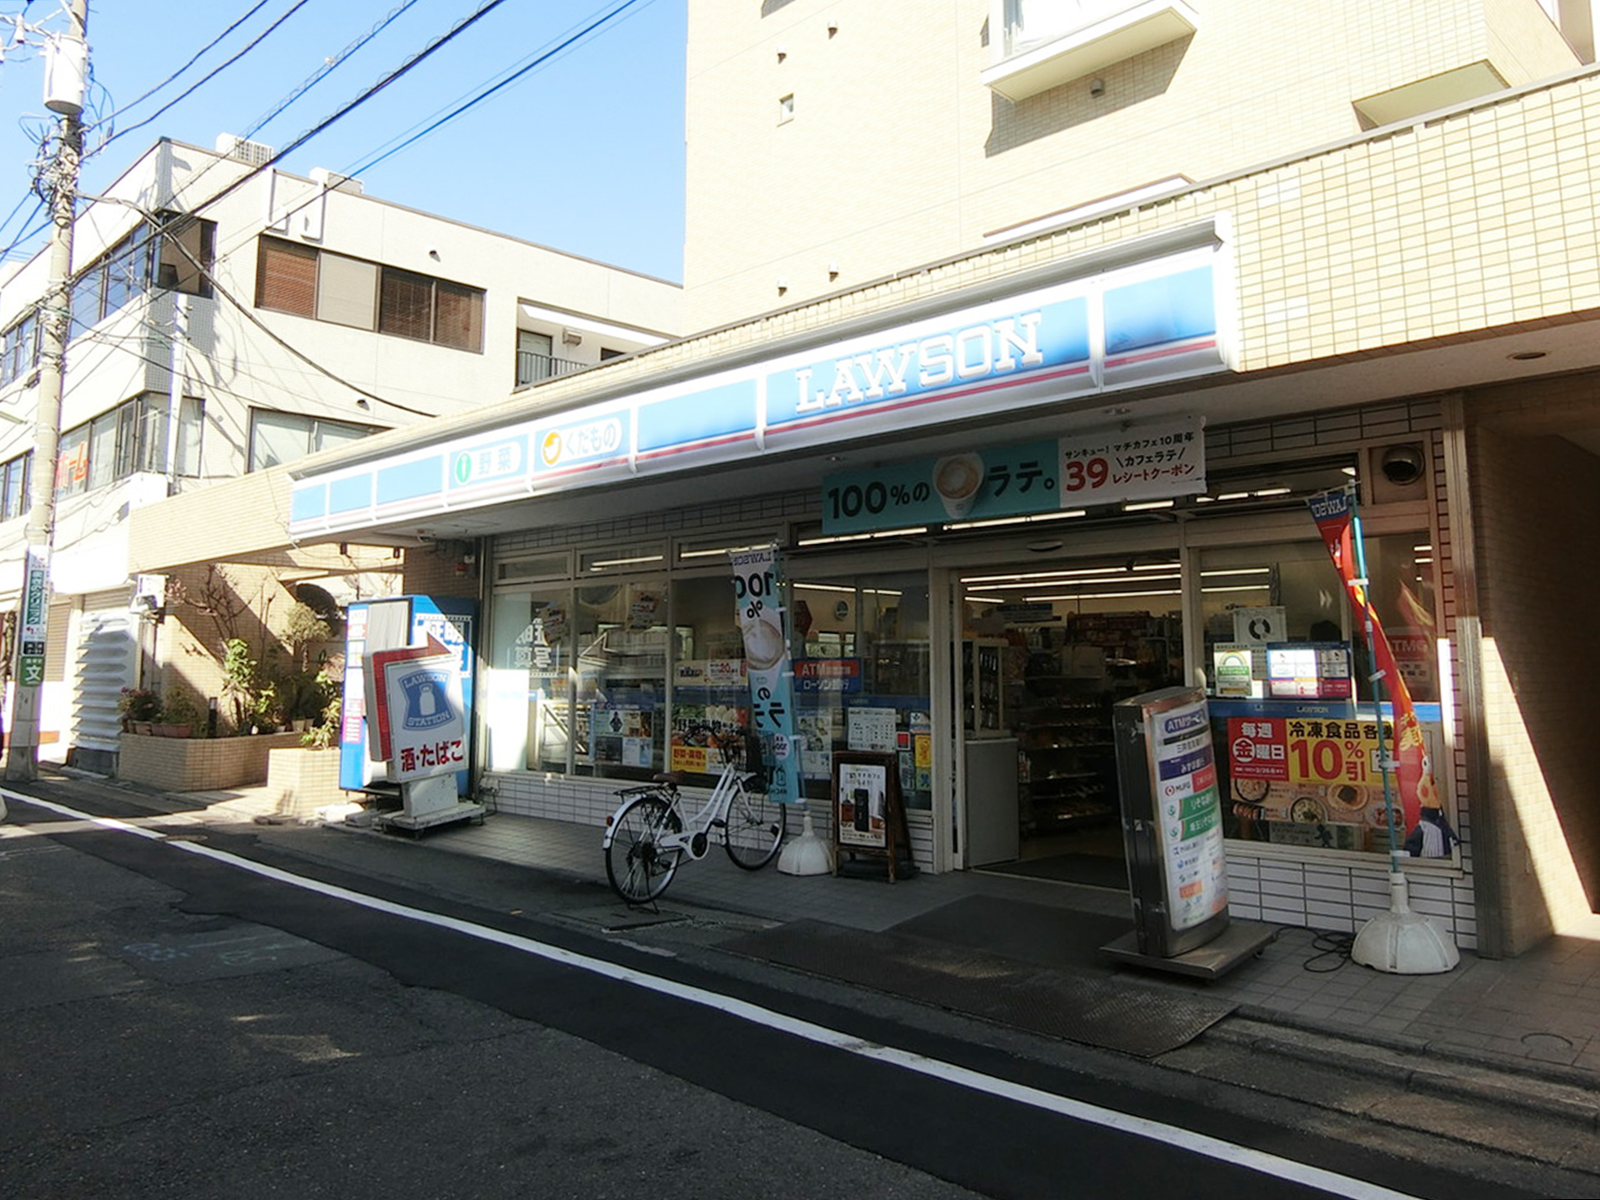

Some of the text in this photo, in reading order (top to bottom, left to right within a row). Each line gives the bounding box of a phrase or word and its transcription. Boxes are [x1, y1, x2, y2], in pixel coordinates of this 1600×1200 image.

[795, 311, 1044, 414] LAWSON
[565, 423, 617, 456] くだもの
[478, 446, 512, 476] 野菜
[1066, 457, 1109, 492] 39
[1112, 463, 1195, 484] レシートクーポン
[828, 480, 931, 519] 100%の
[403, 671, 448, 689] LAWSON
[407, 711, 451, 727] STATION
[1241, 722, 1274, 738] 毎週
[401, 739, 464, 772] 酒・たばこ
[1232, 738, 1286, 763] 金曜日
